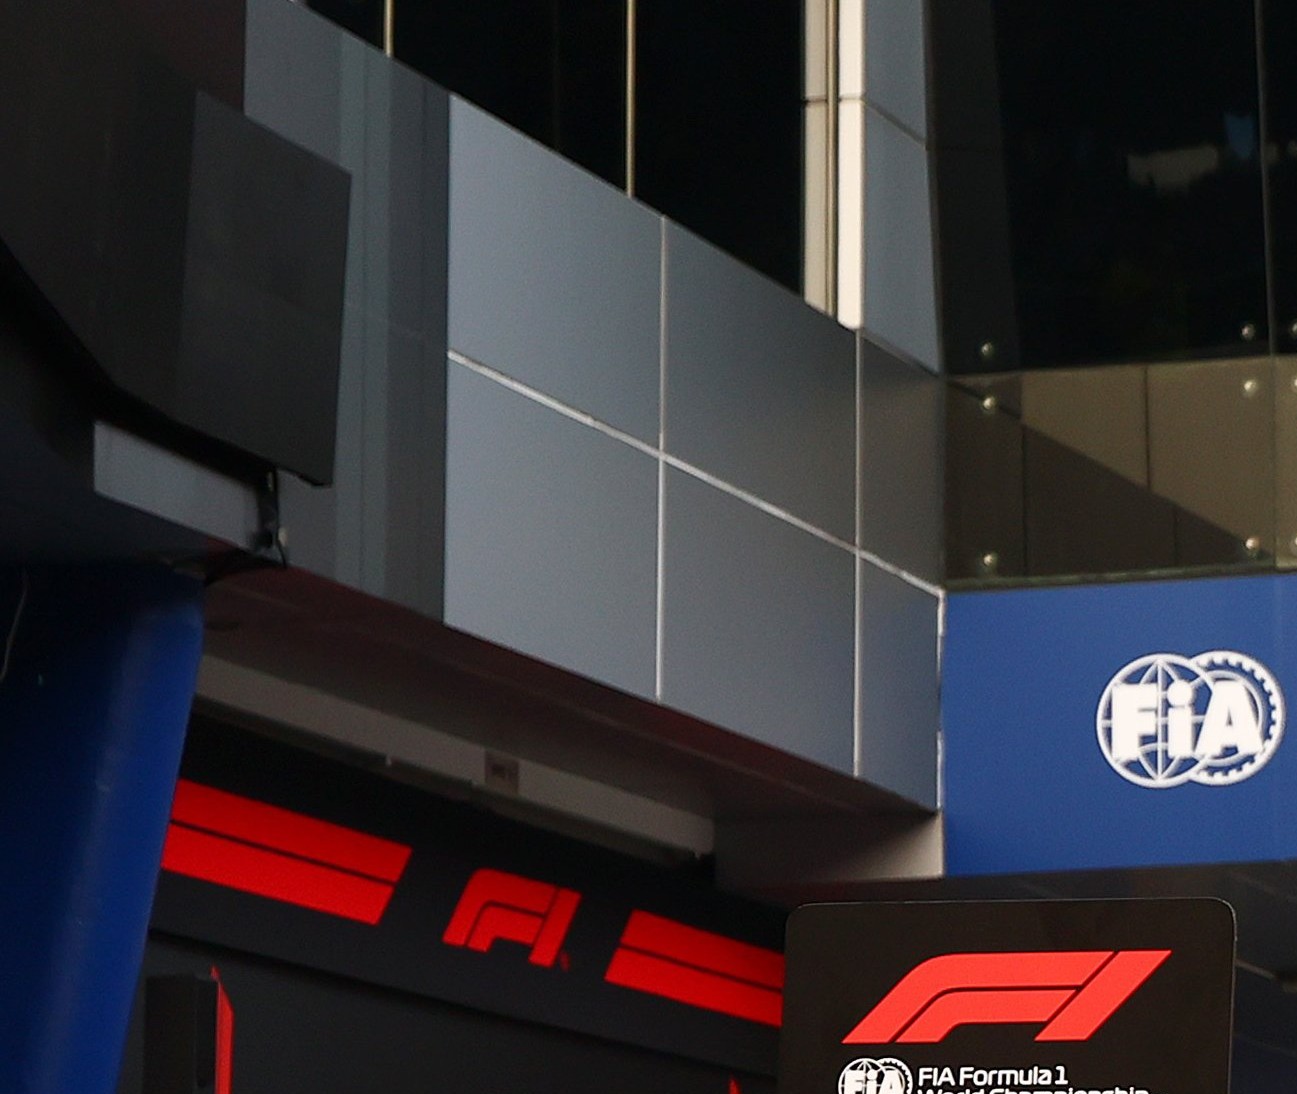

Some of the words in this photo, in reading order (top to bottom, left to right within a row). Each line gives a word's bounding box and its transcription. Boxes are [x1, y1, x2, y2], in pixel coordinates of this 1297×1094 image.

[918, 1066, 959, 1087] FIA
[960, 1066, 1052, 1087] Formula
[1055, 1066, 1068, 1085] 1
